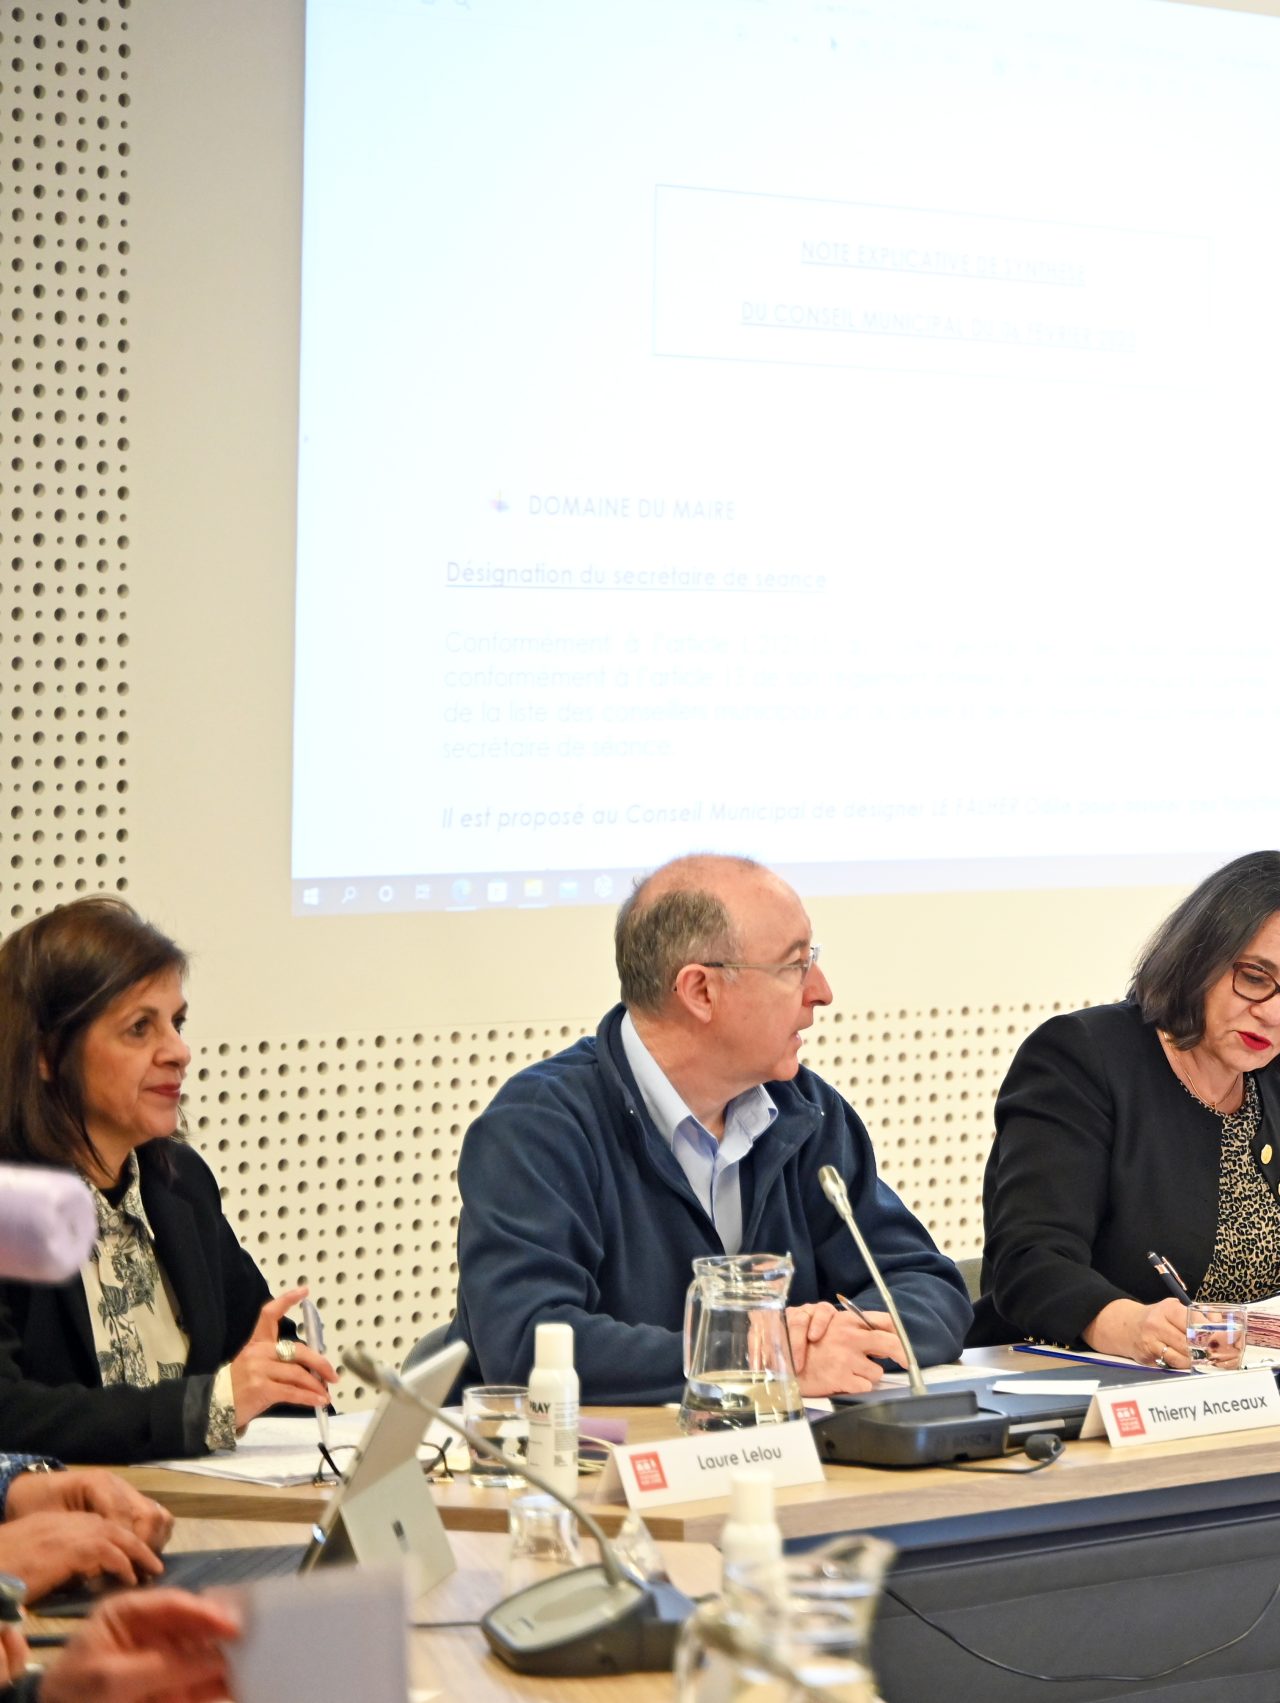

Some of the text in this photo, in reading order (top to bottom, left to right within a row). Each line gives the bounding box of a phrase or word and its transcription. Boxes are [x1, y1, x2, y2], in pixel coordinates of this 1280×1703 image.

[800, 239, 851, 264] NOTE
[741, 300, 766, 322] DU
[774, 302, 855, 328] CONSEIL
[529, 494, 736, 521] DOMAINE DU MAIRE
[445, 560, 574, 588] Désignation
[579, 561, 606, 584] du
[722, 564, 748, 586] de
[443, 699, 472, 722] de
[481, 700, 502, 722] la
[510, 700, 548, 722] liste
[441, 807, 454, 829] Il
[460, 806, 492, 828] est
[497, 804, 585, 832] proposé
[592, 808, 619, 825] au
[626, 800, 703, 825] Conseil
[710, 799, 806, 826] Municipal
[812, 799, 837, 821] de
[1148, 1395, 1268, 1424] Thierry Anceaux
[697, 1446, 783, 1471] Laure Lelou
